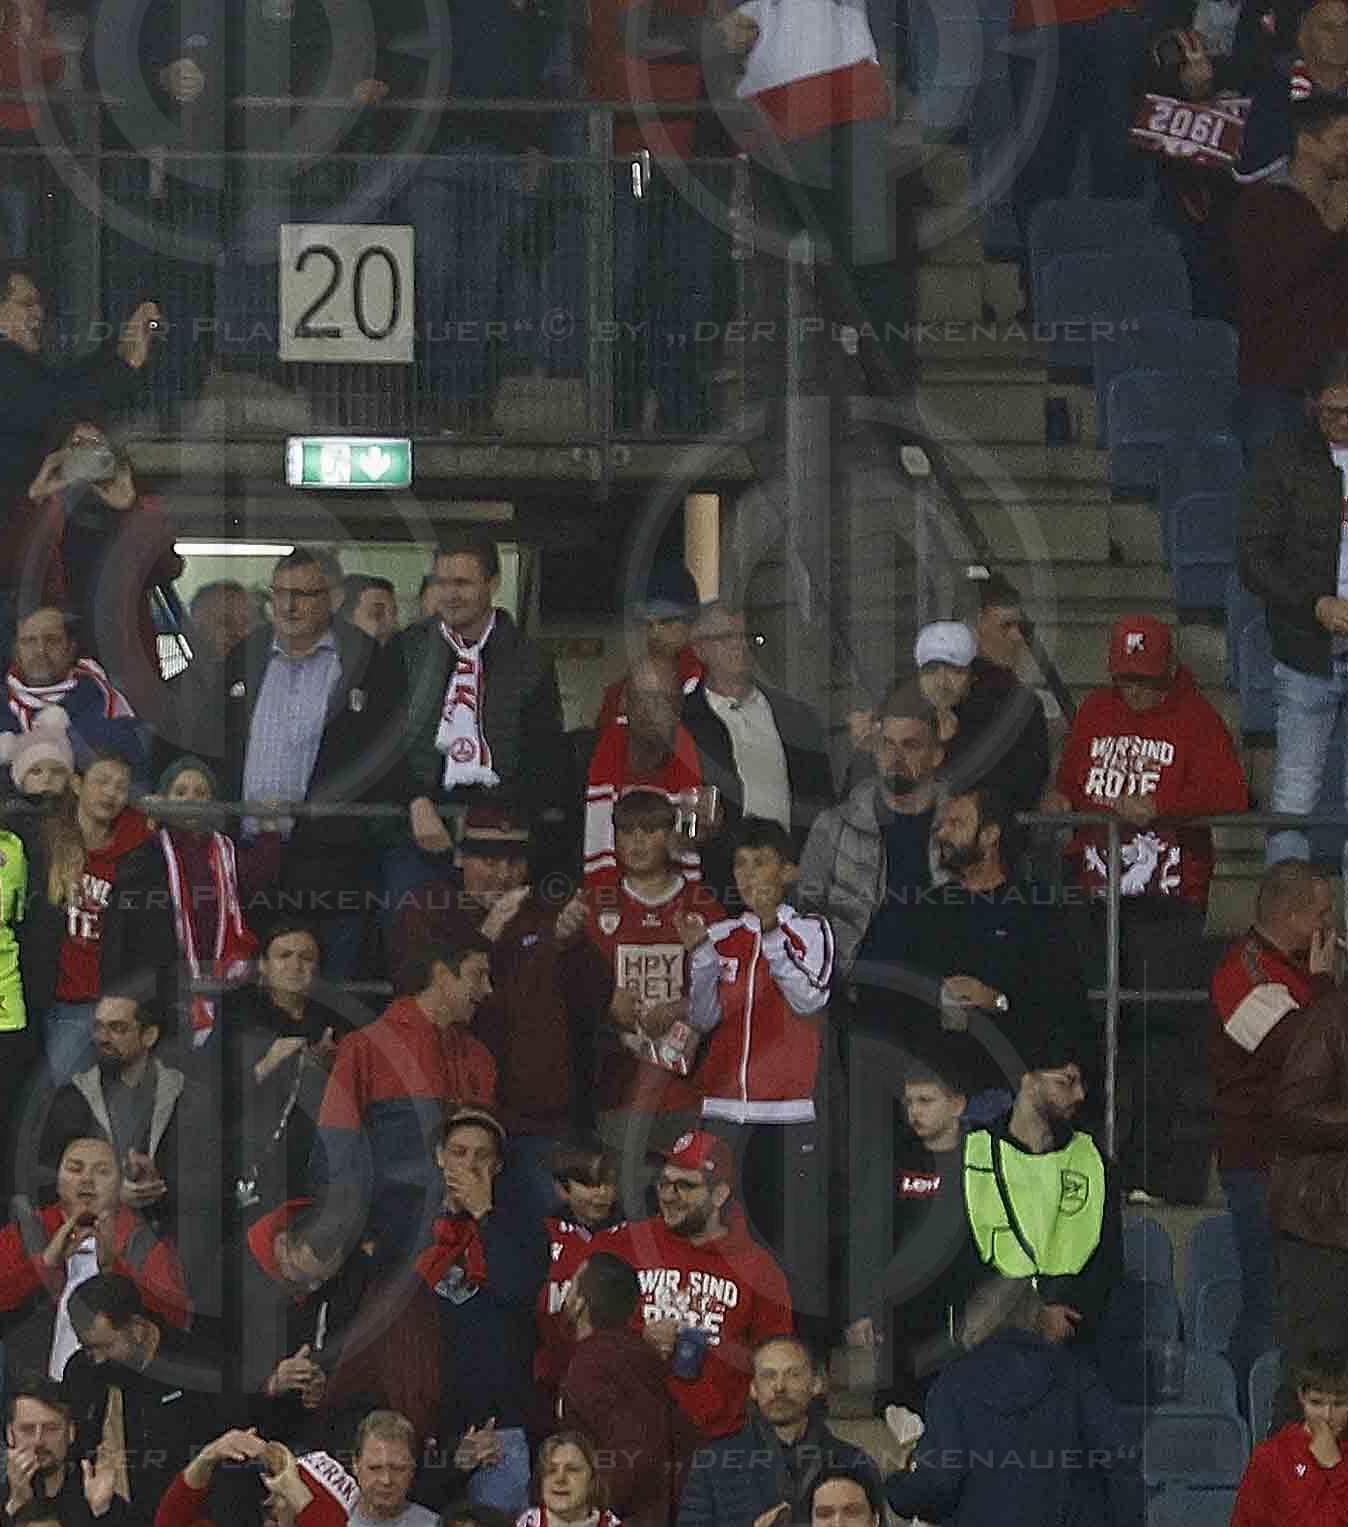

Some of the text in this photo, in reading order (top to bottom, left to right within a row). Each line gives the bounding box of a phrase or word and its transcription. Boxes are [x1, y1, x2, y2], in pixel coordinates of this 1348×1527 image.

[295, 243, 402, 341] 20
[66, 905, 100, 939] TE
[625, 953, 678, 976] HPY
[637, 1267, 682, 1297] WIR
[688, 1273, 740, 1309] SIND
